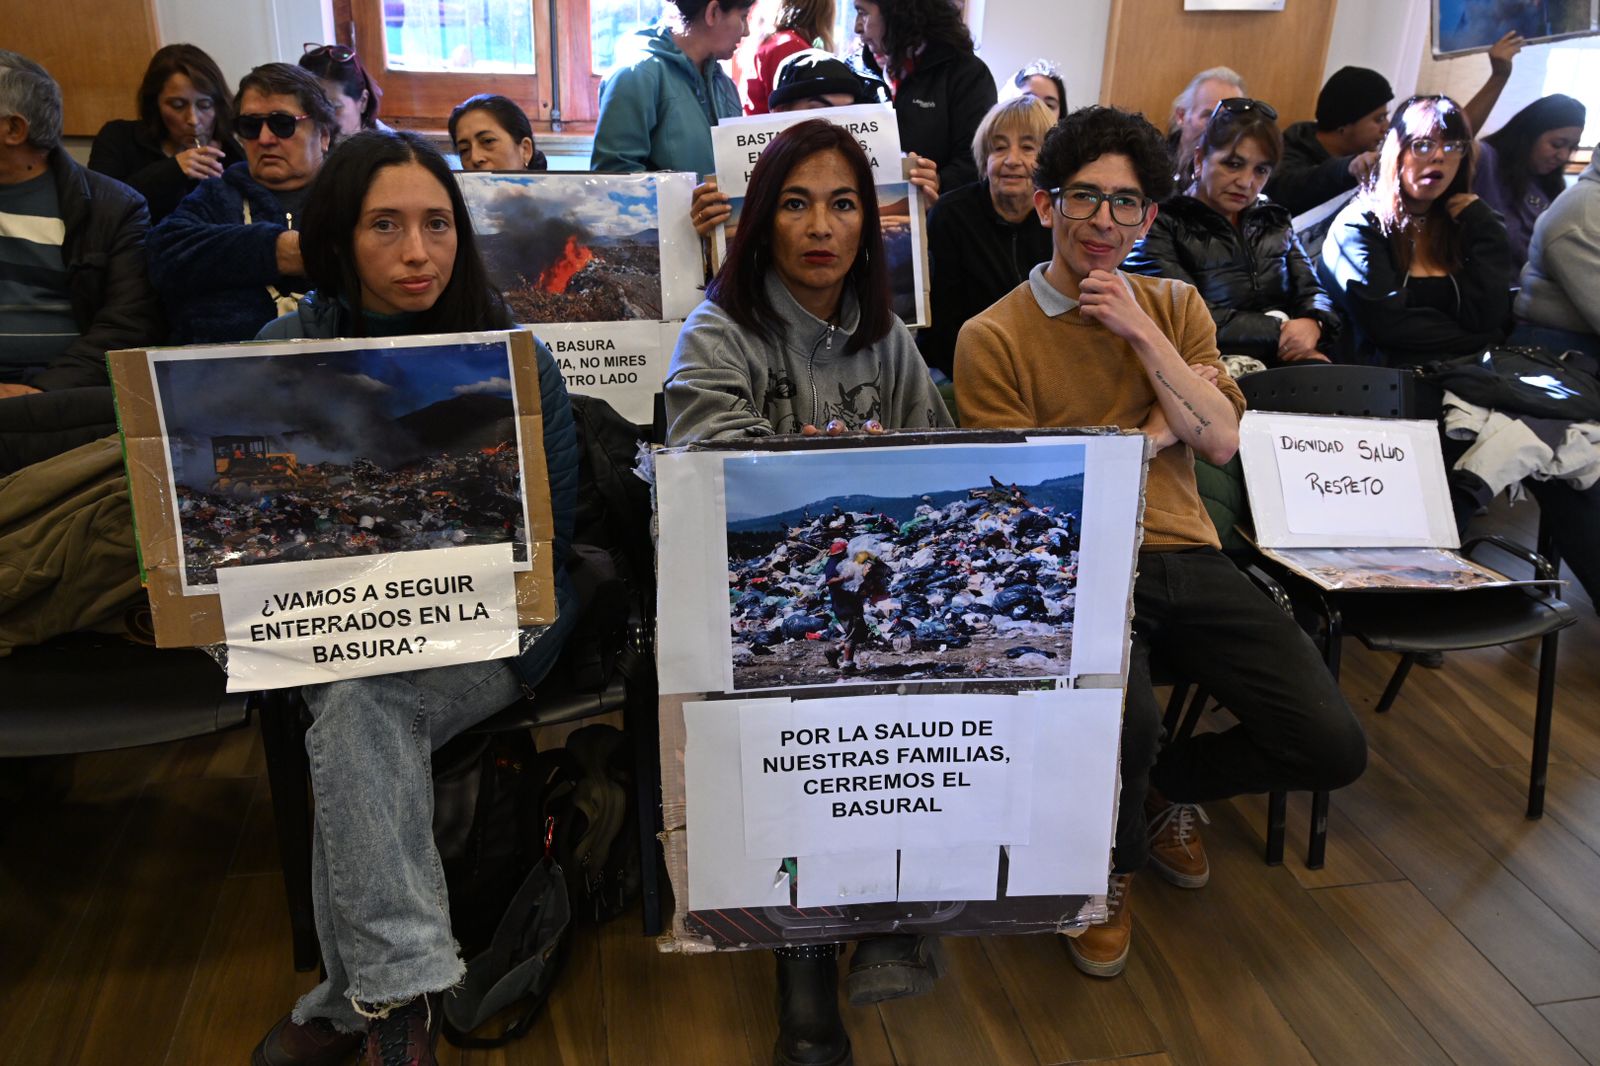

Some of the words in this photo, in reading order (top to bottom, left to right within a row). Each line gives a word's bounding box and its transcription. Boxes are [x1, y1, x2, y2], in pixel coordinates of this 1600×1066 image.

[736, 131, 780, 147] BAST
[556, 339, 615, 352] BASURA
[580, 356, 600, 369] NO
[604, 354, 647, 367] MIRES
[600, 372, 638, 384] LADO
[1358, 439, 1405, 462] SALUD
[1305, 472, 1384, 500] RESPETO
[261, 586, 357, 617] ¿VAMOS
[362, 584, 379, 602] A
[385, 574, 475, 600] SEGUIR
[250, 608, 412, 642] ENTERRADOS
[419, 604, 451, 626] EN
[458, 601, 491, 622] LA
[312, 636, 428, 664] BASURA?
[780, 728, 831, 747] POR
[838, 725, 868, 743] LA
[874, 721, 954, 740] SALUD
[961, 720, 993, 737] DE
[763, 749, 889, 774] NUESTRAS
[897, 745, 1011, 764] FAMILIAS,
[803, 772, 935, 795] CERREMOS
[942, 772, 971, 788] EL
[832, 797, 943, 818] BASURAL
